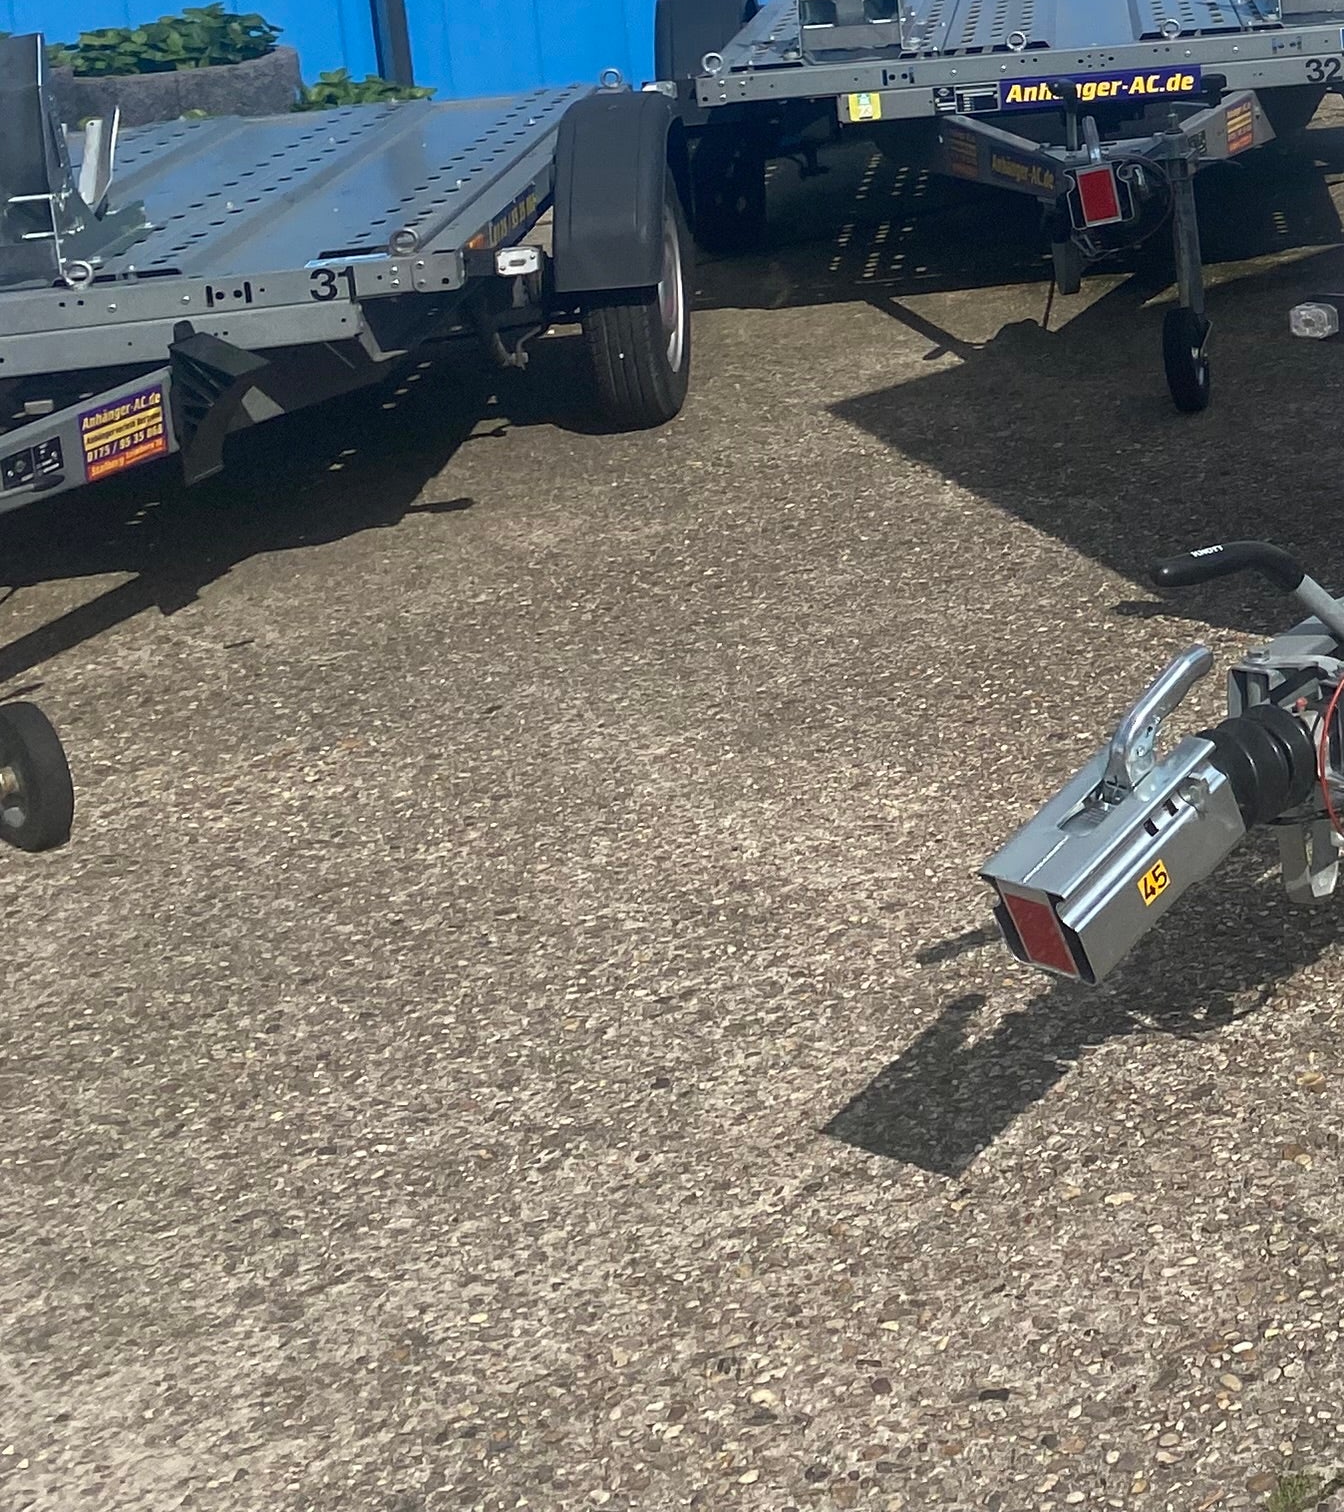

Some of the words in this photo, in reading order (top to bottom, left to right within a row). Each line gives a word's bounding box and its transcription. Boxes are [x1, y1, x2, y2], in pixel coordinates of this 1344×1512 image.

[1305, 58, 1343, 82] 32
[1005, 73, 1194, 102] Anhger-AC.de
[310, 266, 356, 304] 31
[1143, 864, 1167, 899] 45
